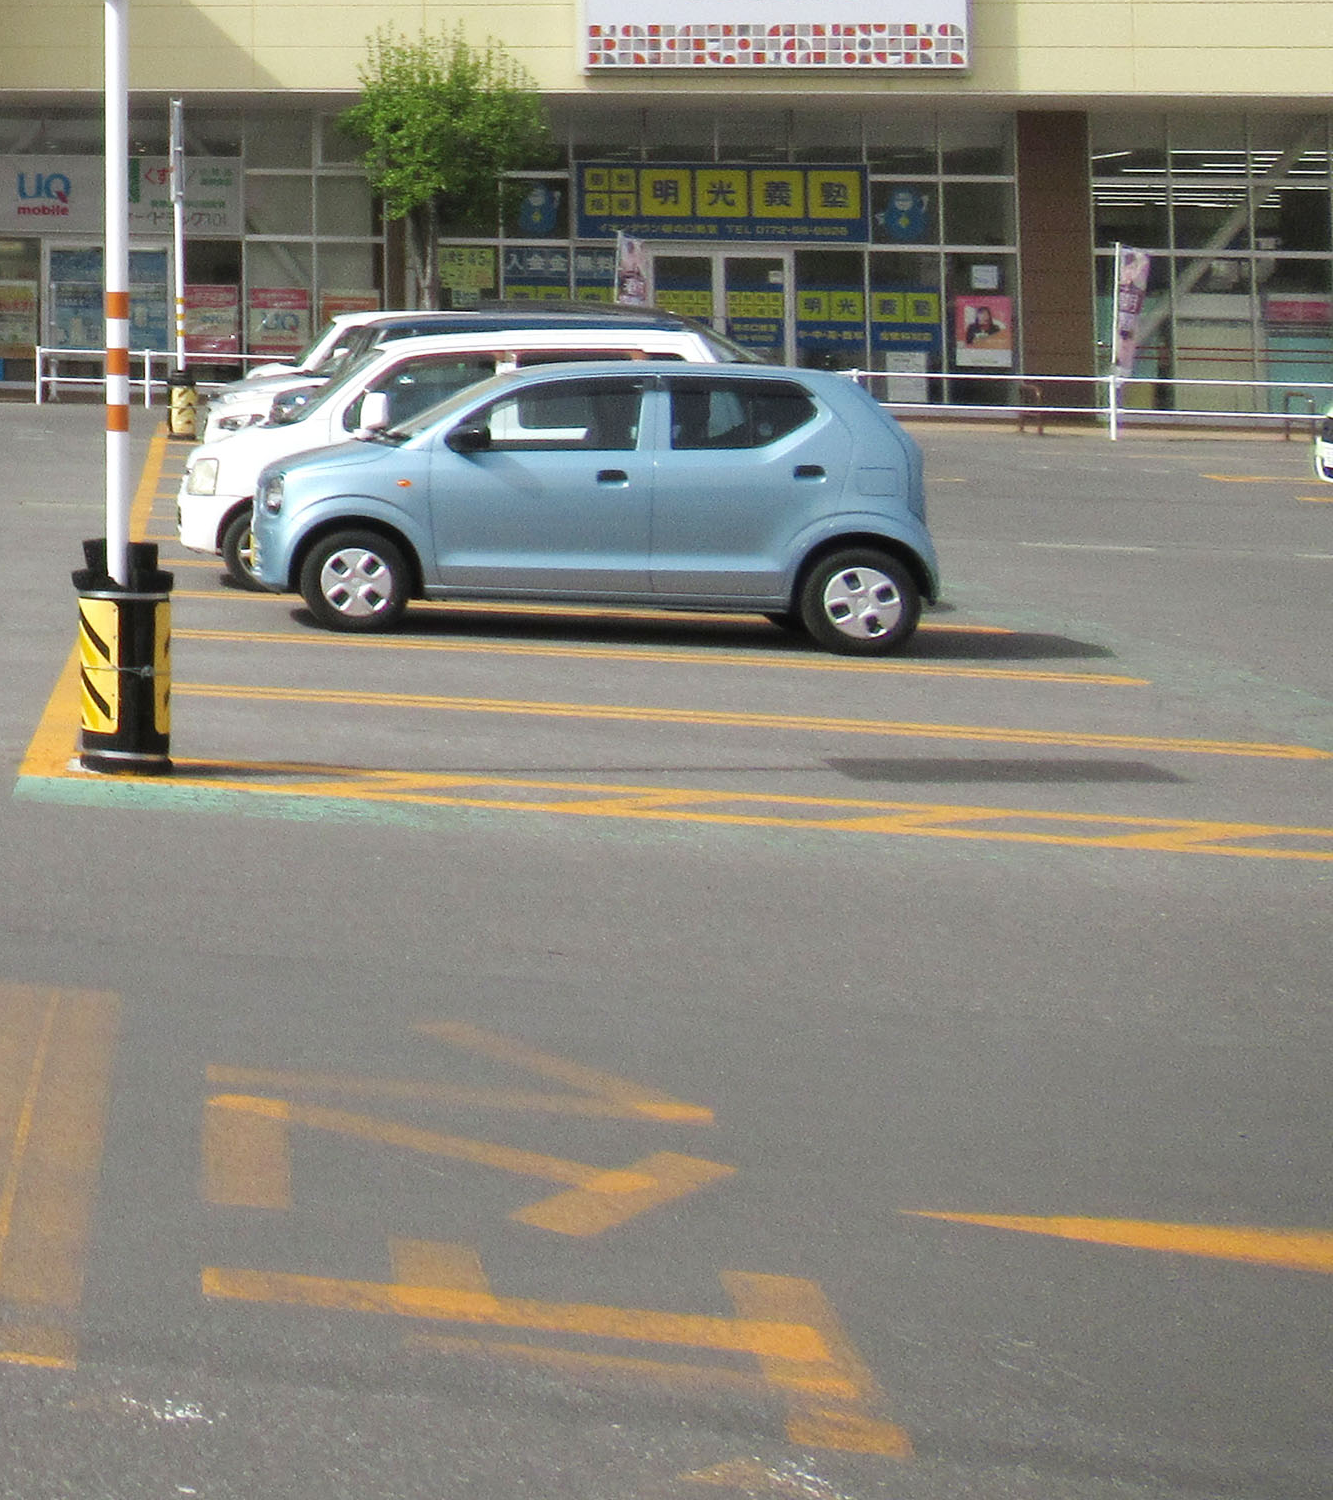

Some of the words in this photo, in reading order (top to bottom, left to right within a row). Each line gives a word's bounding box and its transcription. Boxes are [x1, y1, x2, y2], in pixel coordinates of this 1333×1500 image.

[17, 172, 72, 204] UQ
[652, 178, 850, 209] 明光義塾
[17, 205, 70, 217] mobile
